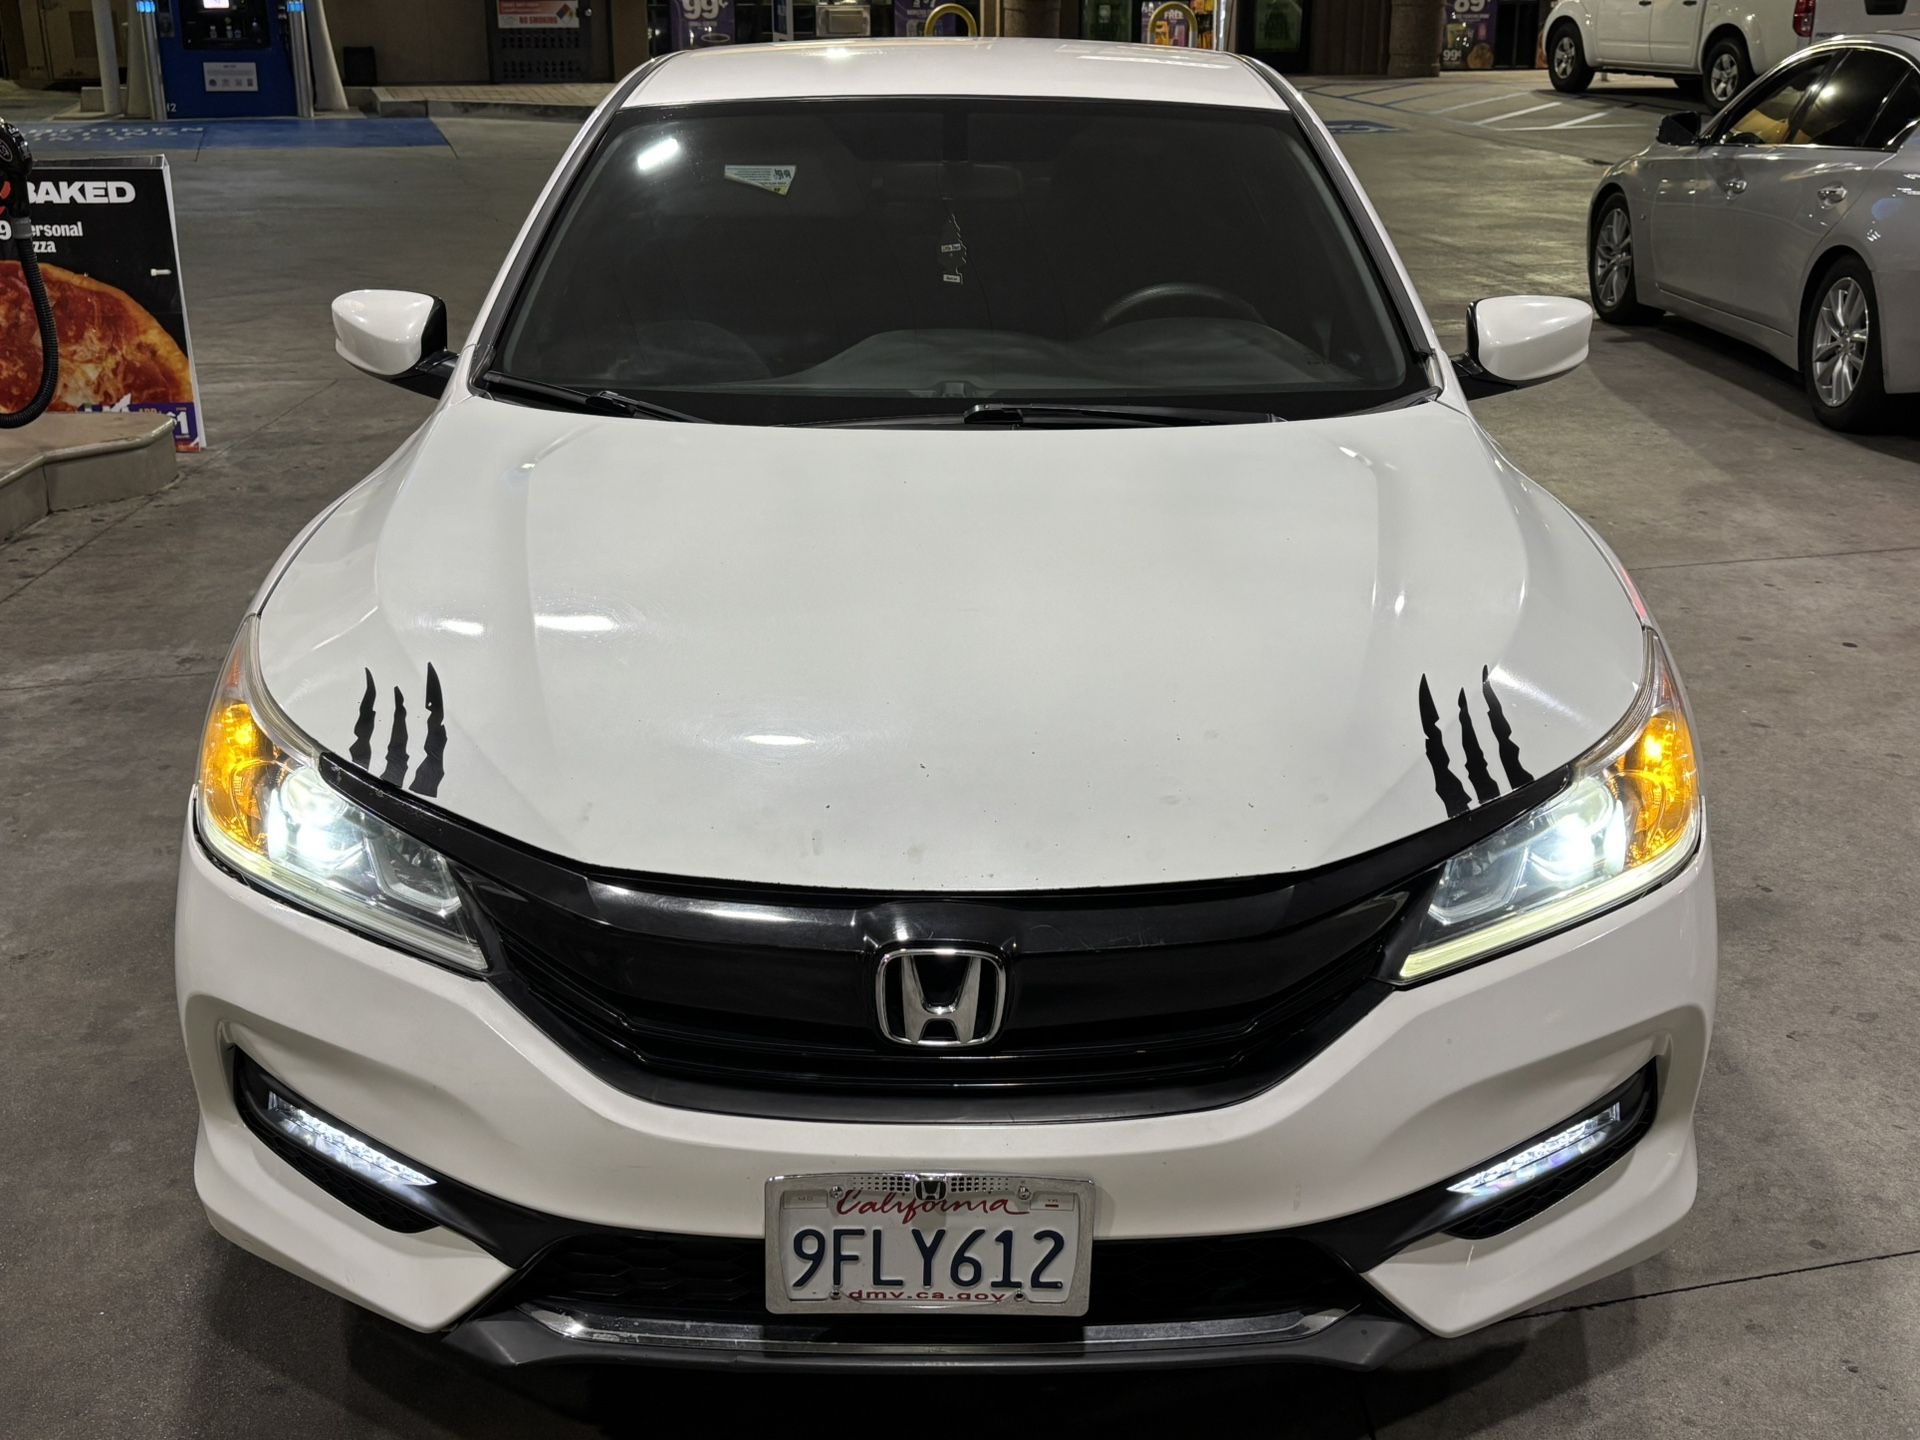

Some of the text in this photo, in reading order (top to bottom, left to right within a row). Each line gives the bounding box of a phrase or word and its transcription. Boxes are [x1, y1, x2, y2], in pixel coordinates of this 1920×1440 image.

[1164, 9, 1184, 20] FREE
[31, 220, 84, 237] ersonal
[32, 240, 57, 253] zza
[836, 1188, 1030, 1225] California
[792, 1228, 1065, 1289] 9FLY612
[848, 1289, 1006, 1303] dmv.ca.gov
